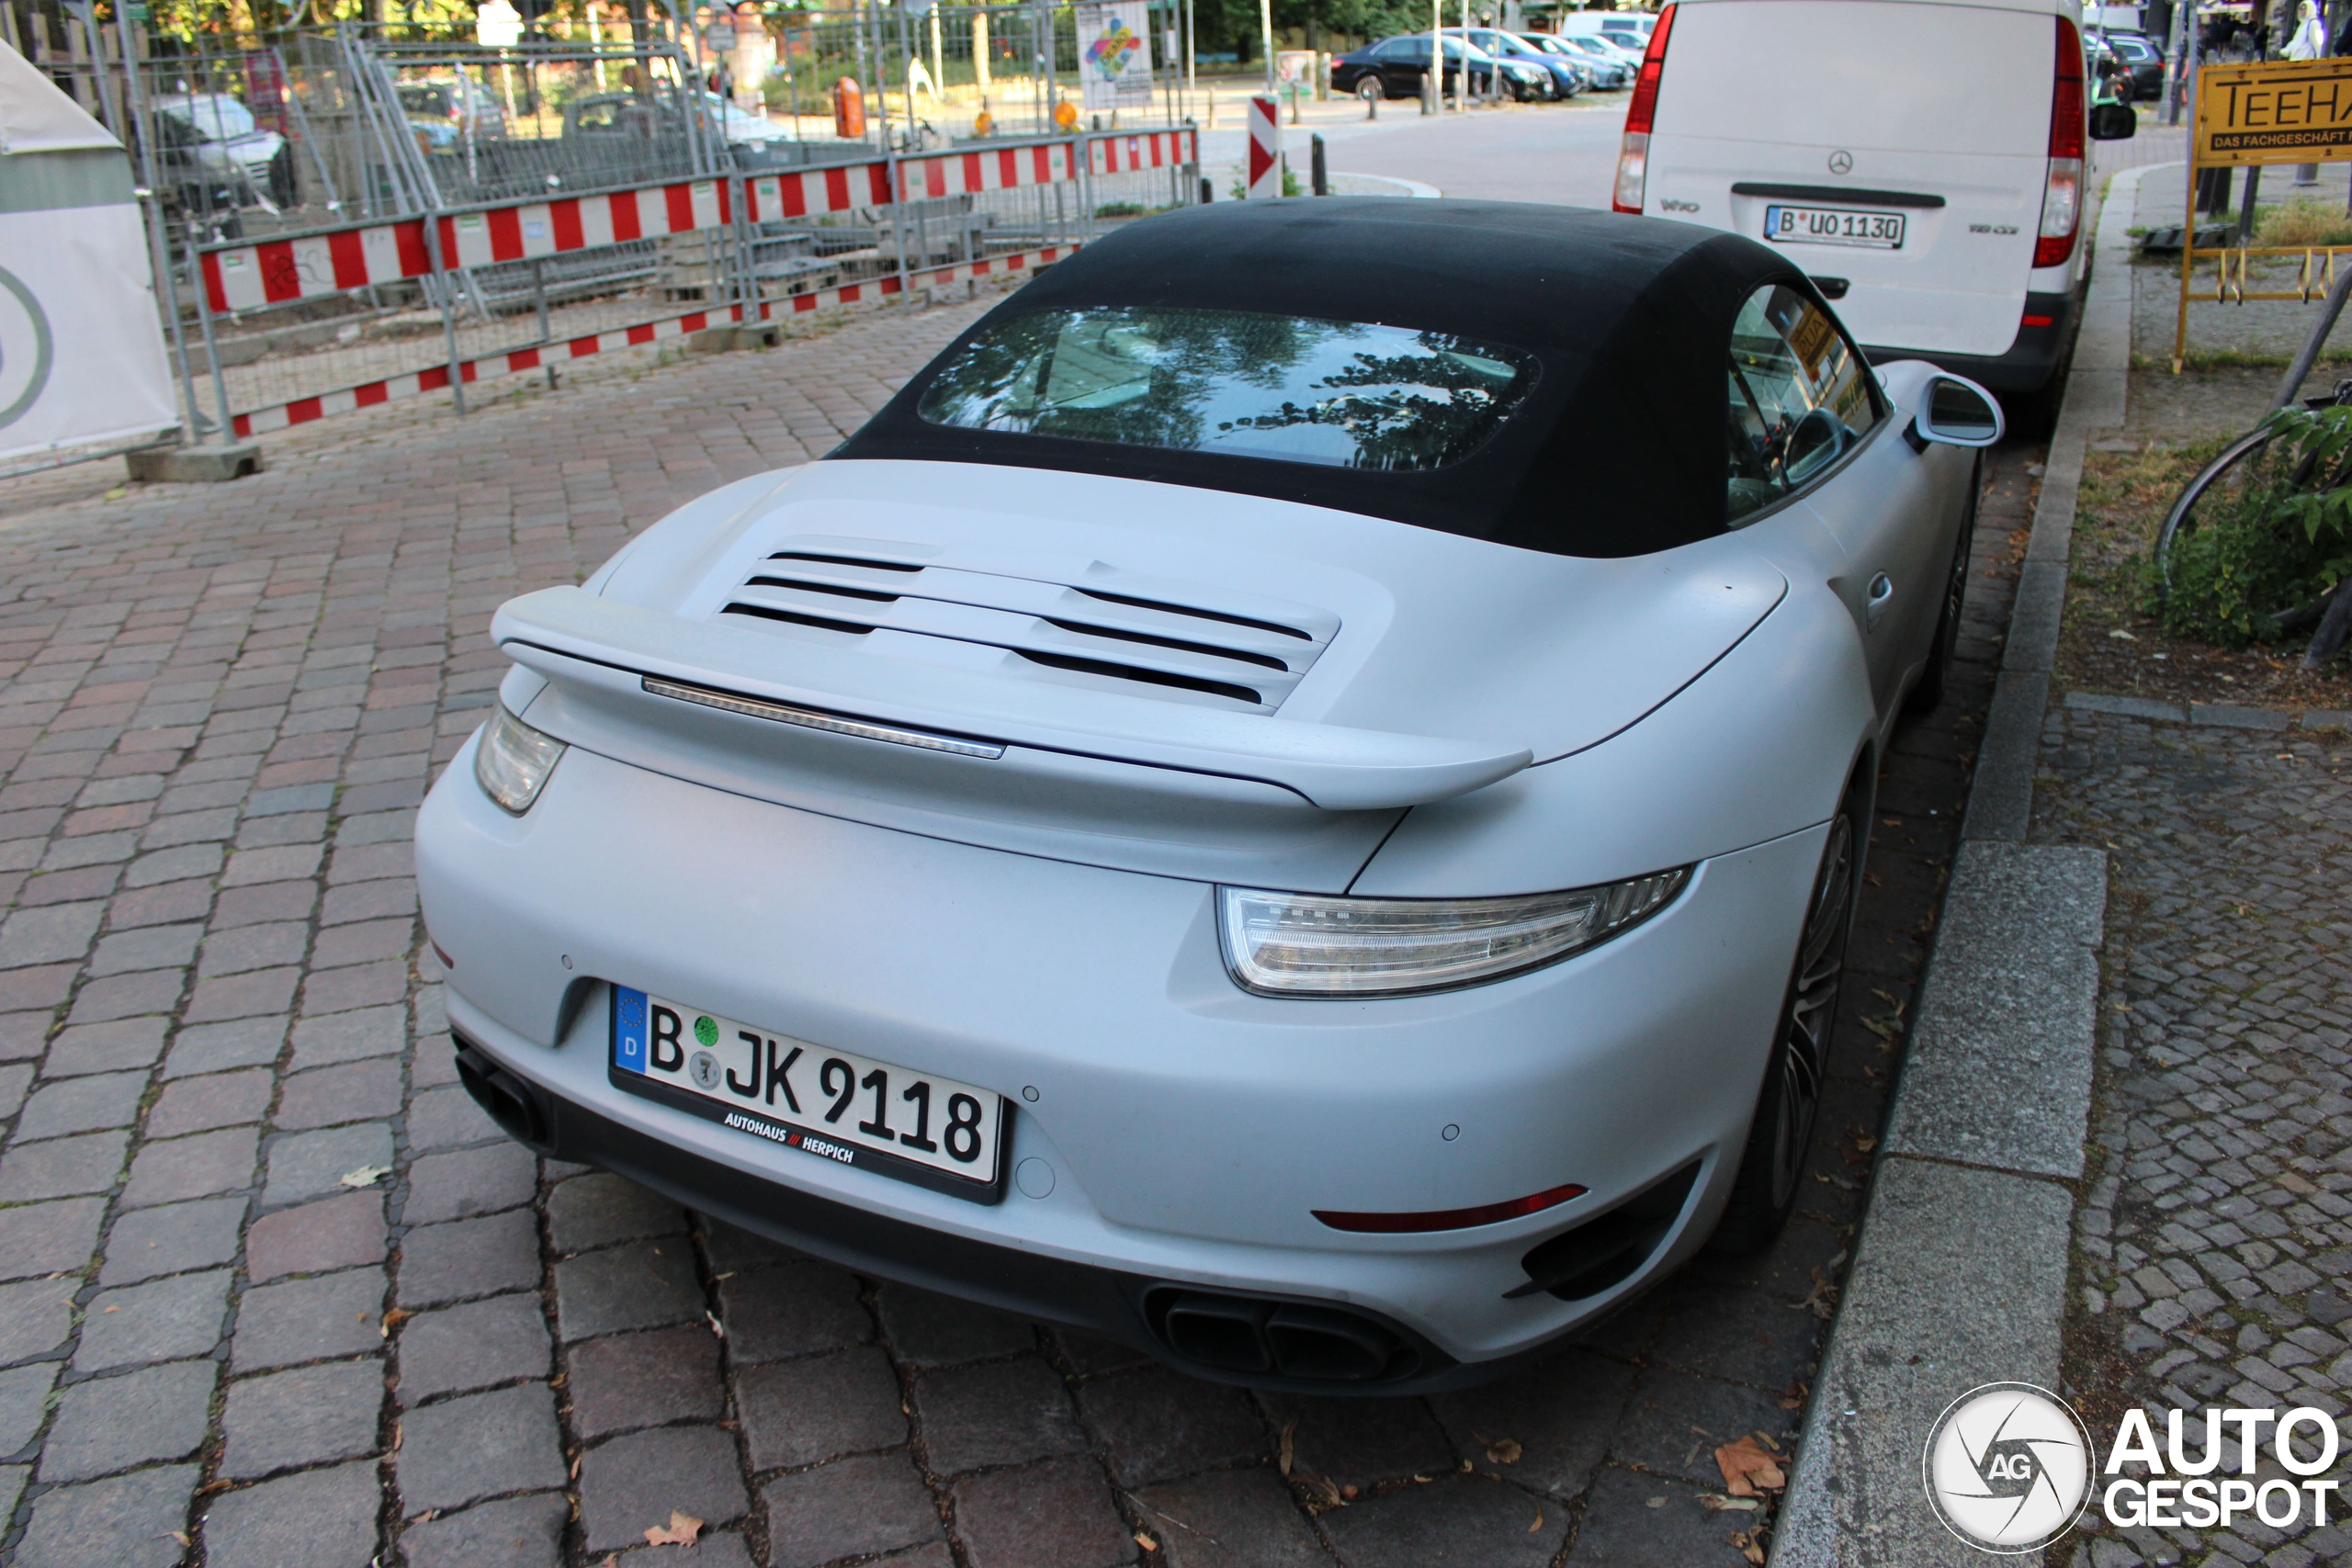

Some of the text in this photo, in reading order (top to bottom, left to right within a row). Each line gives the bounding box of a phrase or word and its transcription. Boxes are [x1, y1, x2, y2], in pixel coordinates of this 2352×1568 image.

[2214, 136, 2240, 148] DAS
[2244, 130, 2346, 147] FACHGESCHÄFT
[1781, 211, 1898, 239] B UO 1130
[626, 1036, 637, 1056] D
[650, 1004, 982, 1163] B JK 9118
[724, 1112, 854, 1164] AUTOHAUS HERPICH
